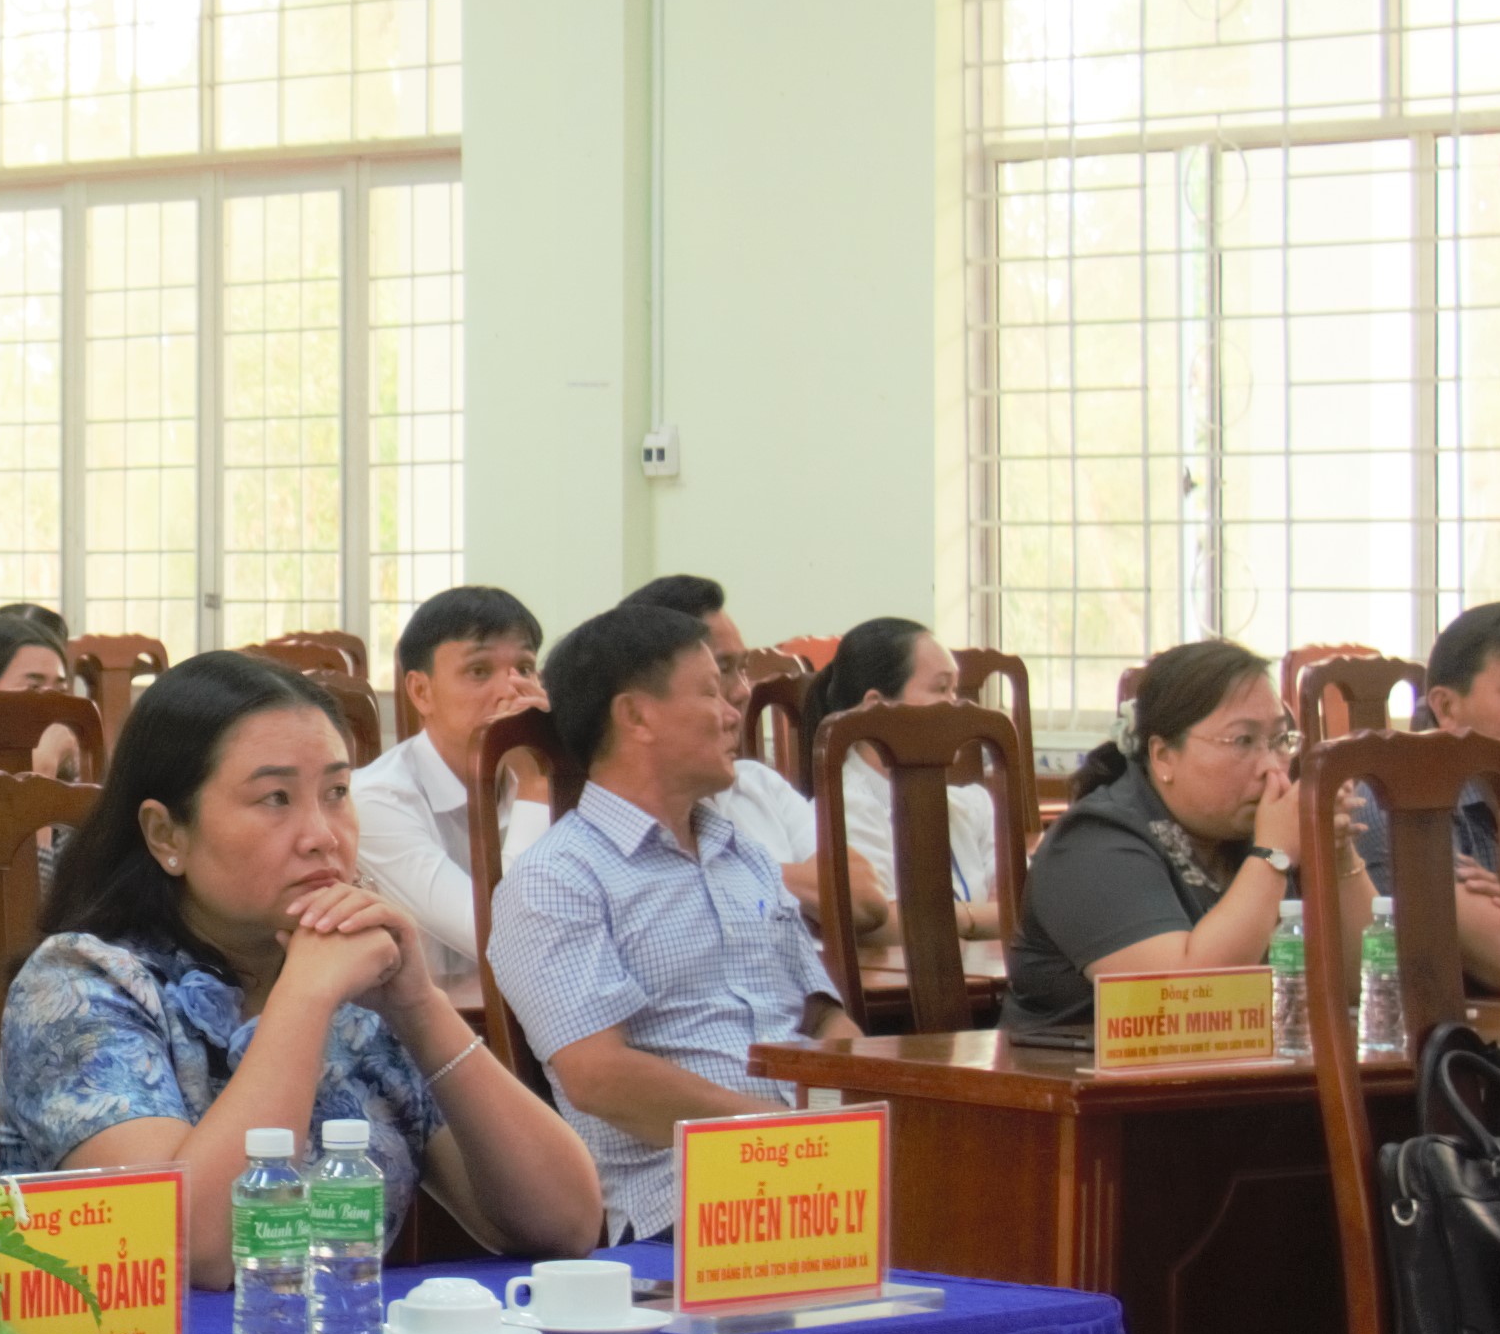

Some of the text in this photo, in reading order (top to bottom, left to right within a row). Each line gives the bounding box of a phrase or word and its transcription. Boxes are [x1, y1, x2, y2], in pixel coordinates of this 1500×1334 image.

[1107, 1003, 1265, 1039] NGUYỄN MINH TRÍ
[740, 1135, 829, 1167] Đồng chí:
[70, 1199, 112, 1226] chí:
[698, 1181, 867, 1248] NGUYỄN TRÚC LY
